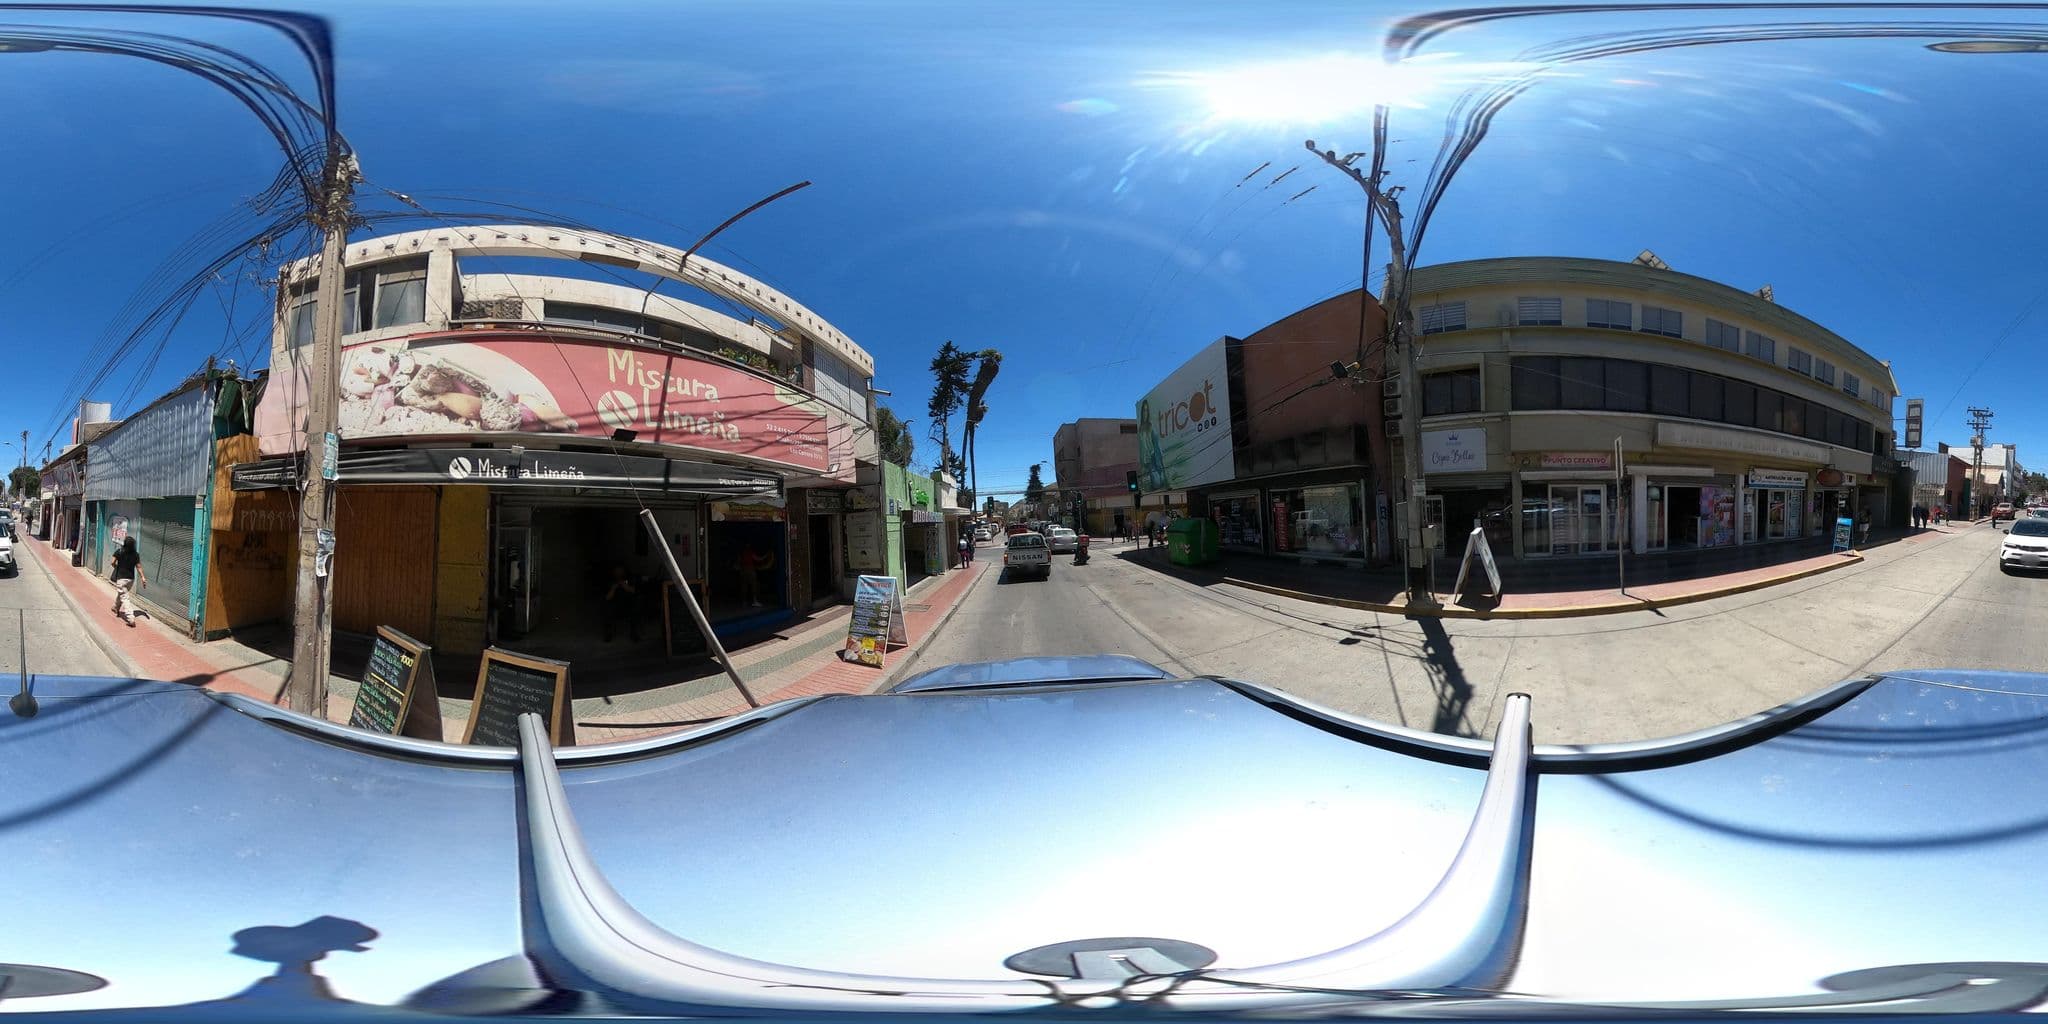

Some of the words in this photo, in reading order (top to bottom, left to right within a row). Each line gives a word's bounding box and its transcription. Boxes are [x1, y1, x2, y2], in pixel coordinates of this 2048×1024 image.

[607, 347, 720, 404] Mistura
[643, 384, 741, 443] Limeña
[1159, 379, 1216, 438] tricot
[535, 460, 584, 480] Limeña
